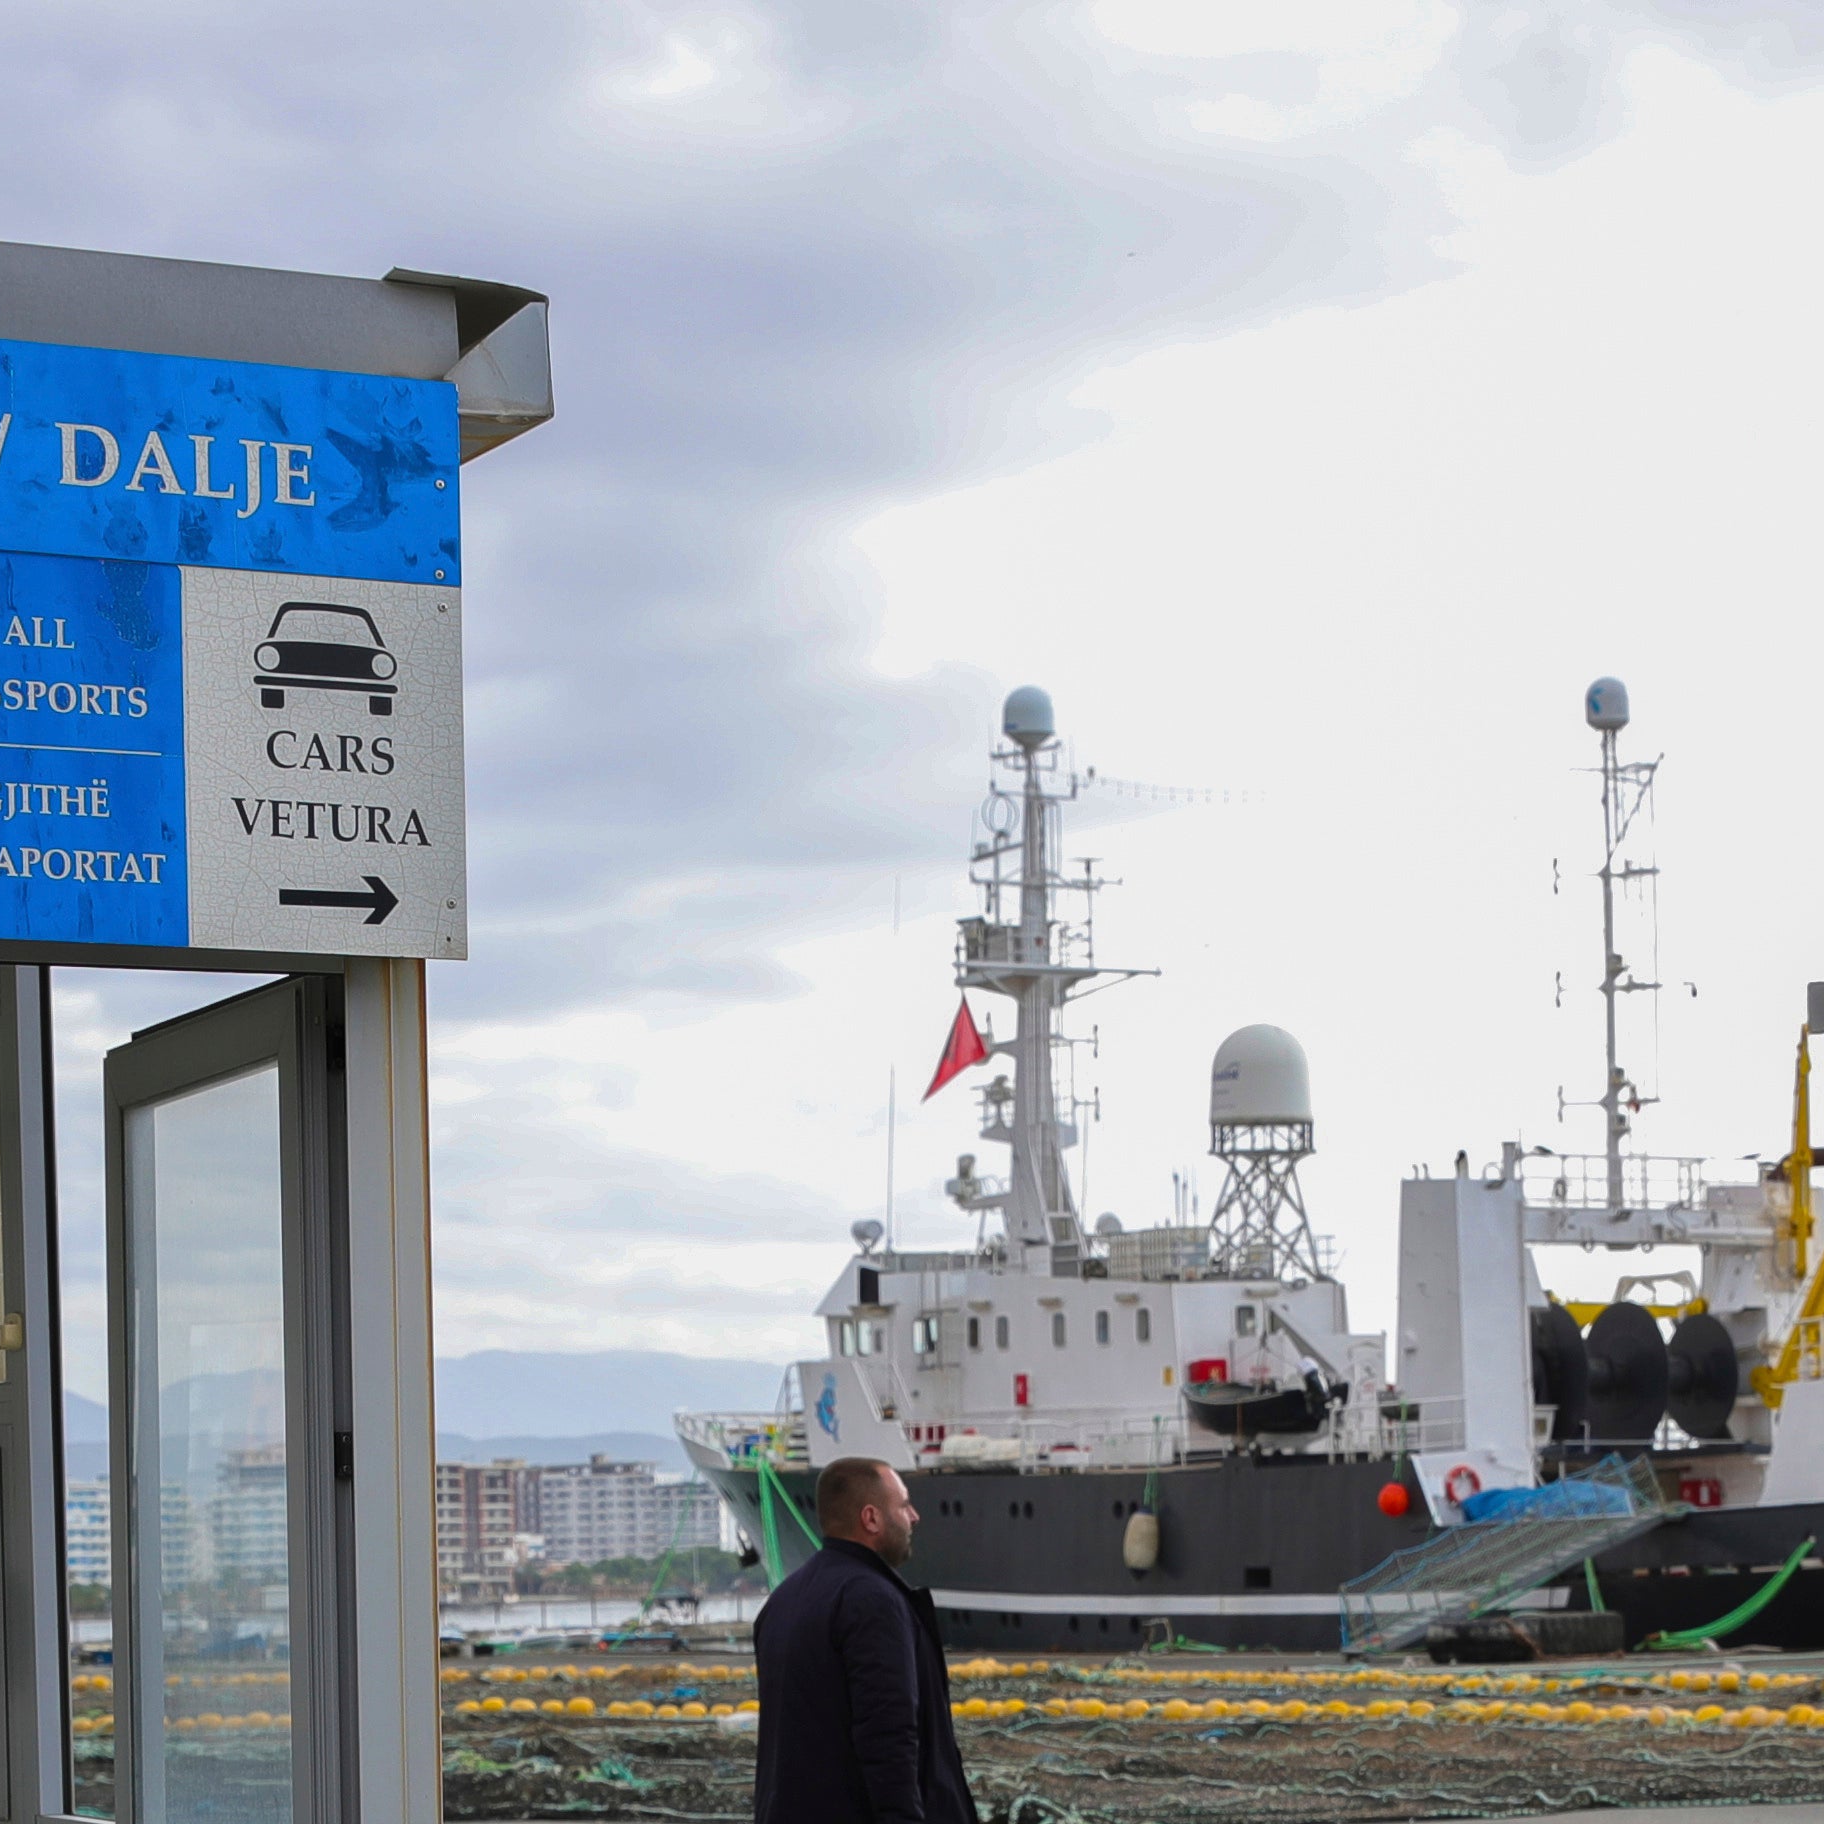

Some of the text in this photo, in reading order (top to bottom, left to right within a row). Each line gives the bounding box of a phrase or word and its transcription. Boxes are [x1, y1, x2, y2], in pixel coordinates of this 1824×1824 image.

[54, 421, 318, 519] DALJE
[3, 616, 75, 650] ALL
[265, 730, 395, 776] CARS
[231, 797, 432, 847] VETURA
